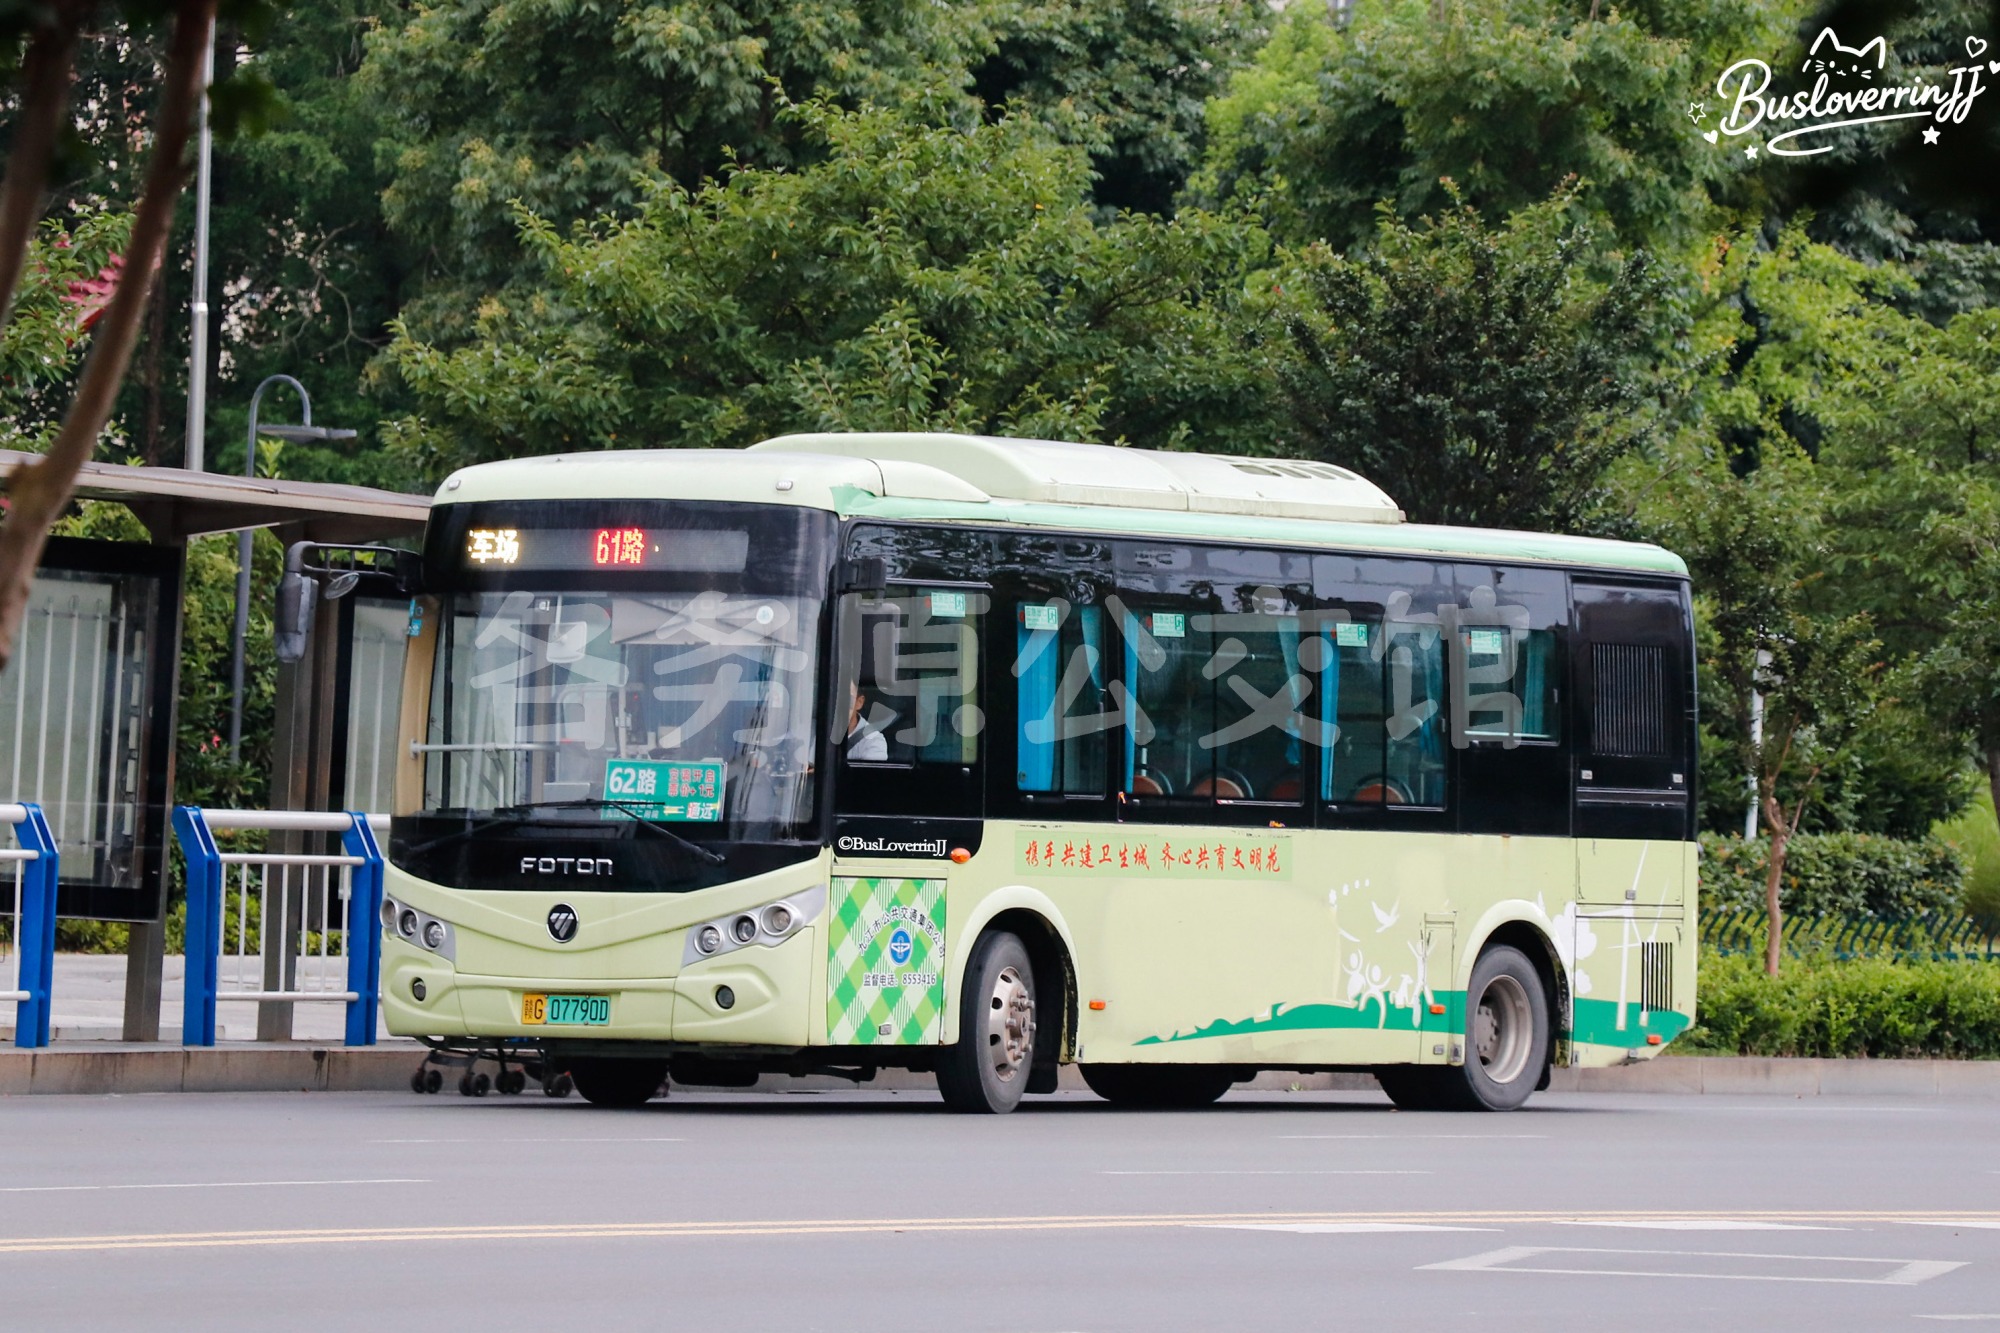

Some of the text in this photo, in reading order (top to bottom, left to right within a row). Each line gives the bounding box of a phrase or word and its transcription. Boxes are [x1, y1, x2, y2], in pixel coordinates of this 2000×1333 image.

[597, 529, 645, 564] 61路
[609, 767, 715, 796] 62路 空调开启
[686, 802, 713, 819] 通远
[520, 857, 614, 876] FOTON
[1025, 840, 1281, 873] 携手共建卫生城 齐心共育文明花
[858, 904, 946, 958] 九江市公共交通集团公司
